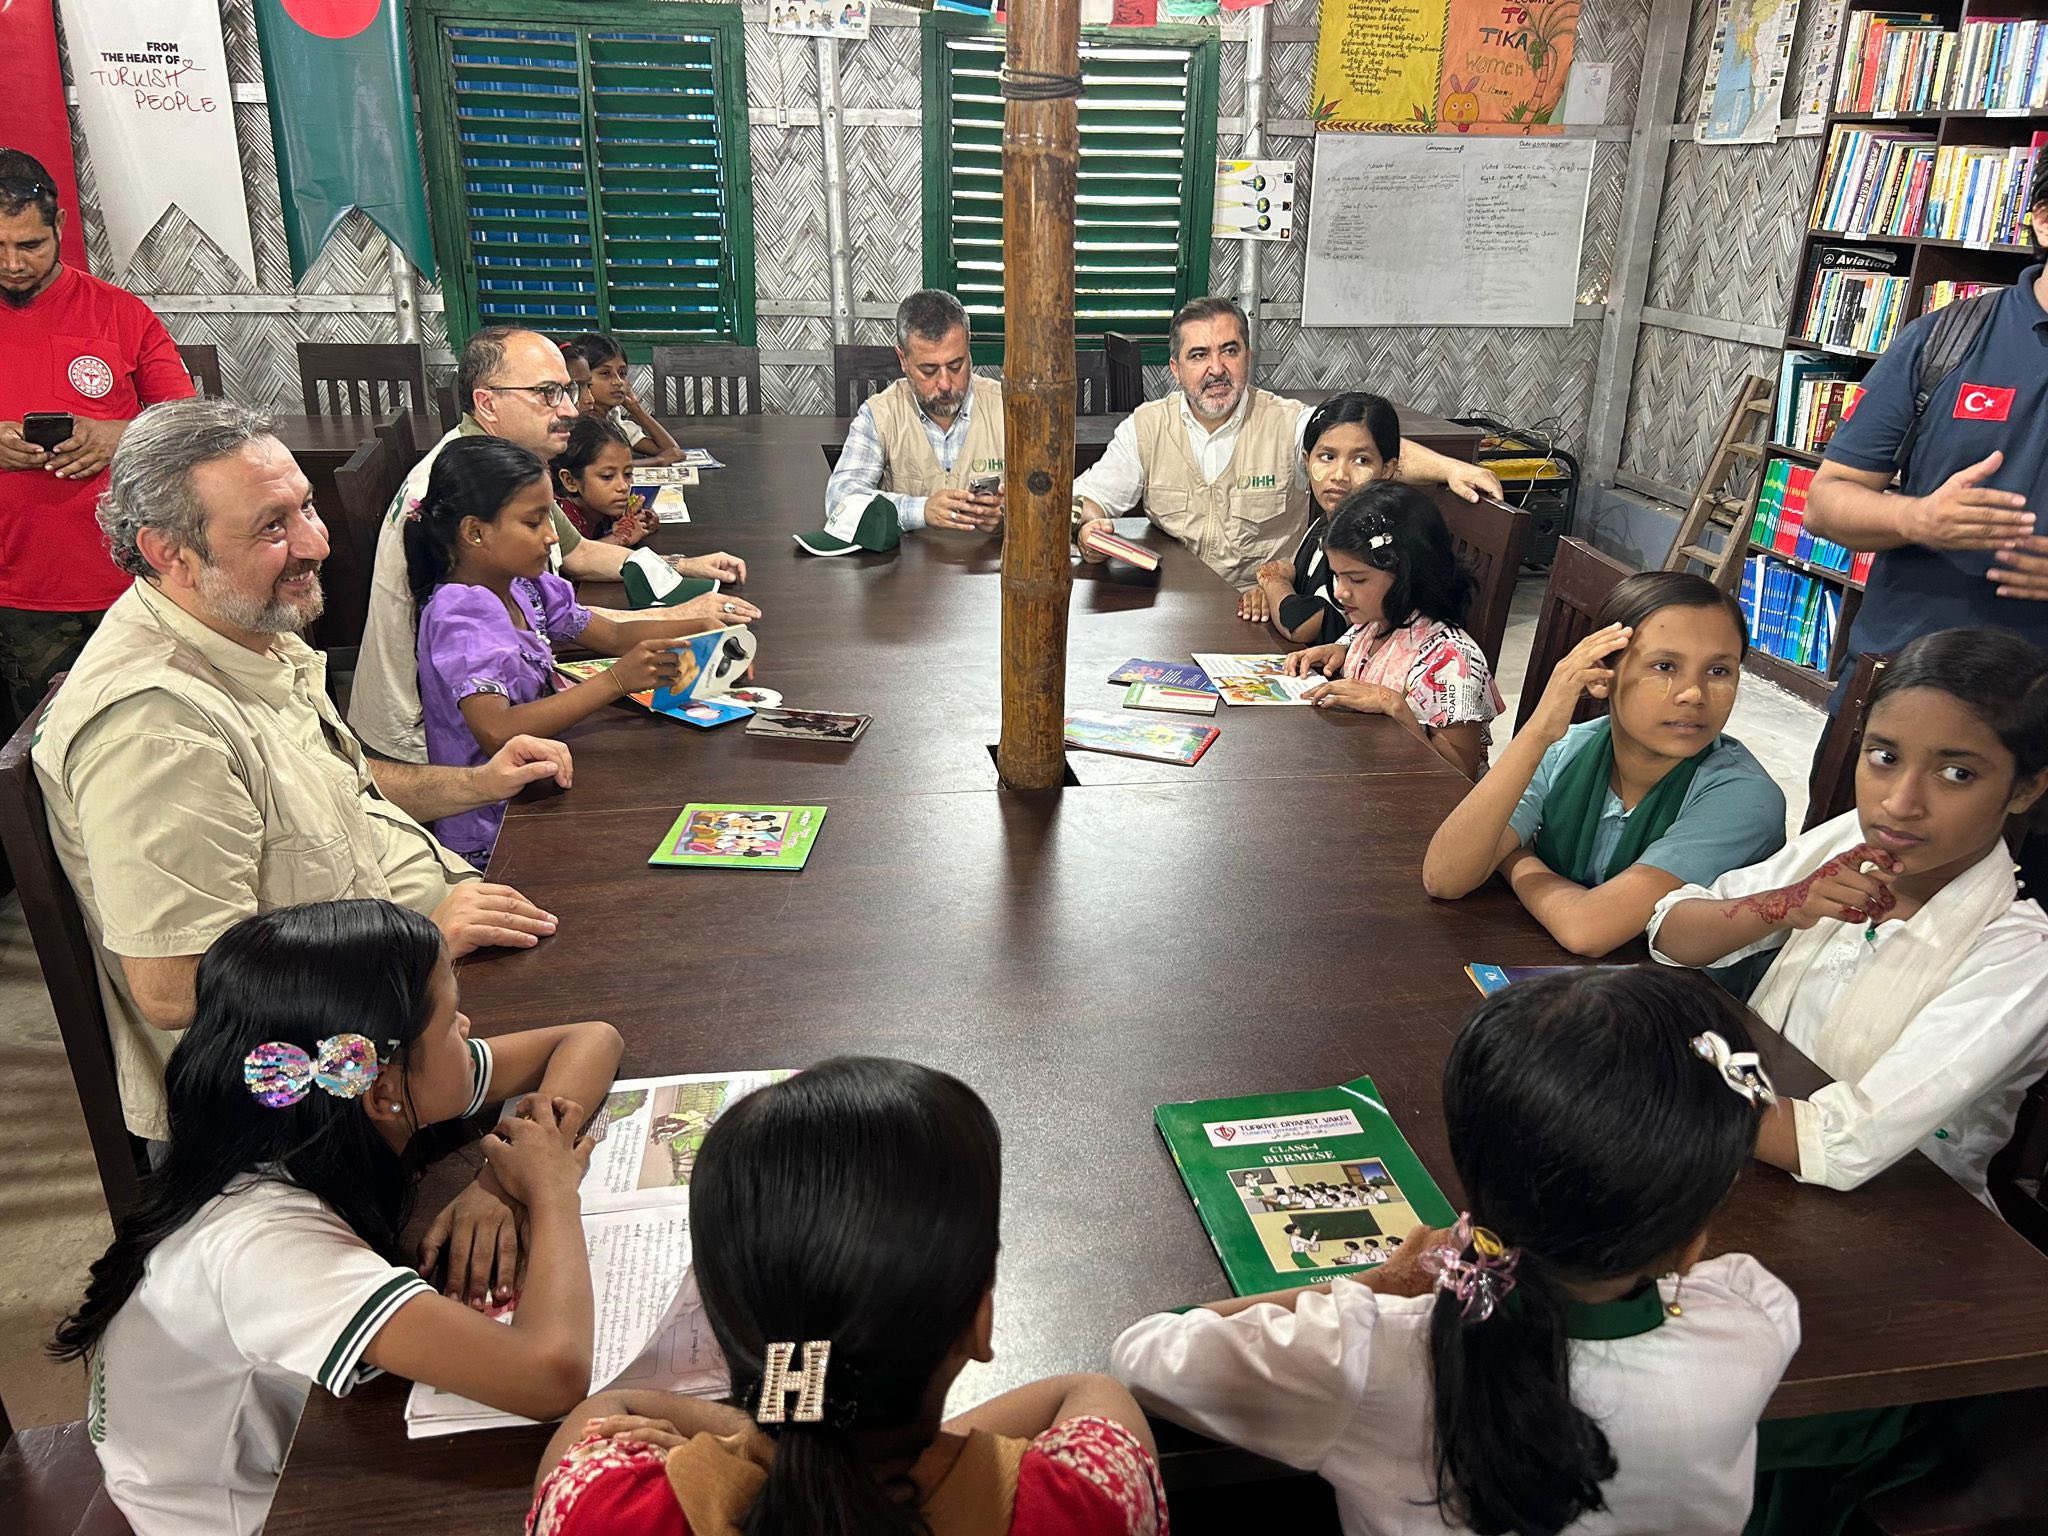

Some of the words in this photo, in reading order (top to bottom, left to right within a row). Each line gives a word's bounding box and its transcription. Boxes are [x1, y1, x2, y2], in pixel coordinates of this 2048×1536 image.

[1501, 6, 1529, 25] TO
[146, 42, 179, 53] FROM
[1479, 27, 1529, 52] TIKA
[101, 52, 124, 62] THE
[126, 53, 162, 64] HEART
[165, 55, 180, 65] OF
[90, 66, 182, 88] TURKISH
[134, 89, 217, 112] PEOPLE
[1836, 254, 1891, 269] Aviation
[1262, 1150, 1336, 1164] BURMESE
[757, 1340, 832, 1424] H
